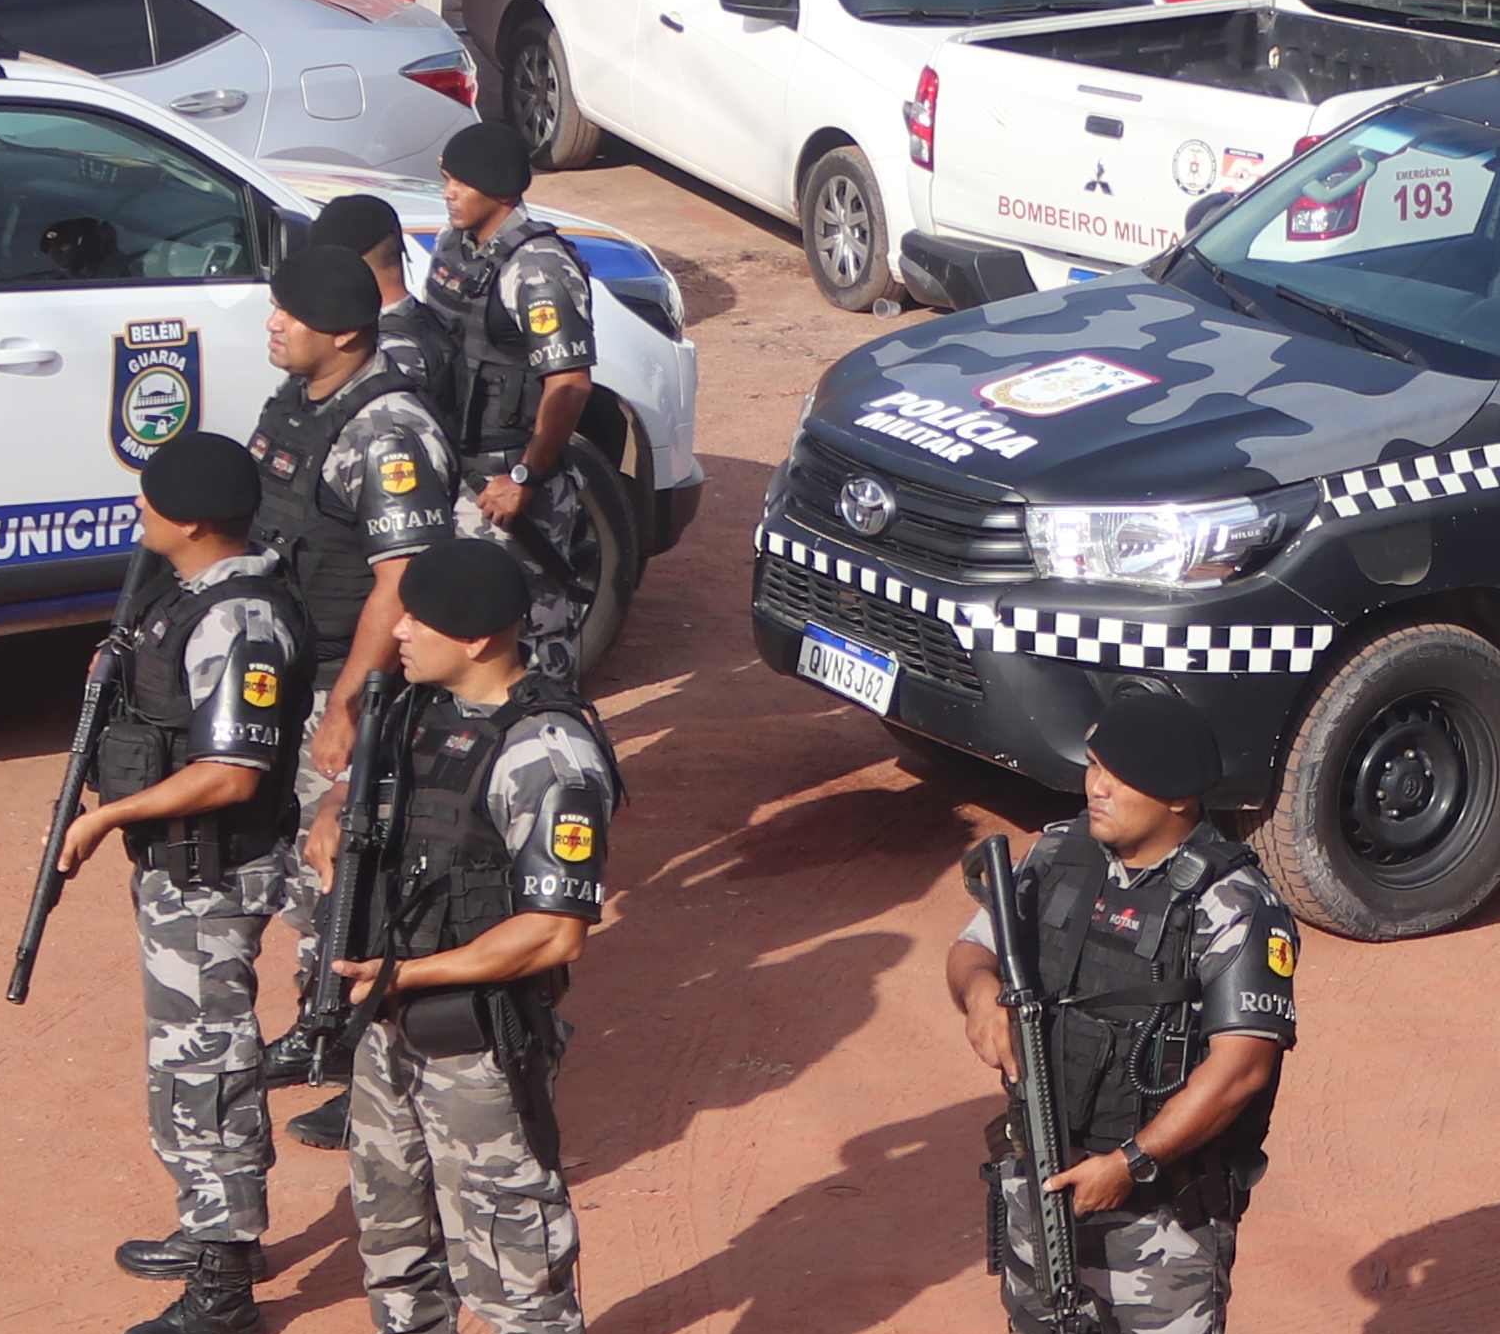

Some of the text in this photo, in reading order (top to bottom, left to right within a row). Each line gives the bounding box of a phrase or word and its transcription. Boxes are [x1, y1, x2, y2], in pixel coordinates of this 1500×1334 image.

[1395, 166, 1452, 181] EMERGÊNCIA
[1392, 181, 1453, 222] 193
[996, 194, 1180, 250] BOMBEIRO MILITA
[130, 320, 183, 345] BELÉM
[127, 348, 189, 375] GUARDA
[528, 339, 588, 368] ROTAM
[853, 411, 976, 464] MILITAR
[869, 390, 1040, 461] POLÍCIA
[365, 507, 445, 537] ROTAM
[1230, 528, 1261, 541] HILUX
[809, 644, 885, 705] QVN3J62
[211, 721, 279, 748] ROTA
[558, 812, 592, 826] PMPA
[553, 832, 593, 849] ROTAM
[1108, 912, 1141, 933] ROTAM
[1239, 991, 1296, 1023] ROTA
